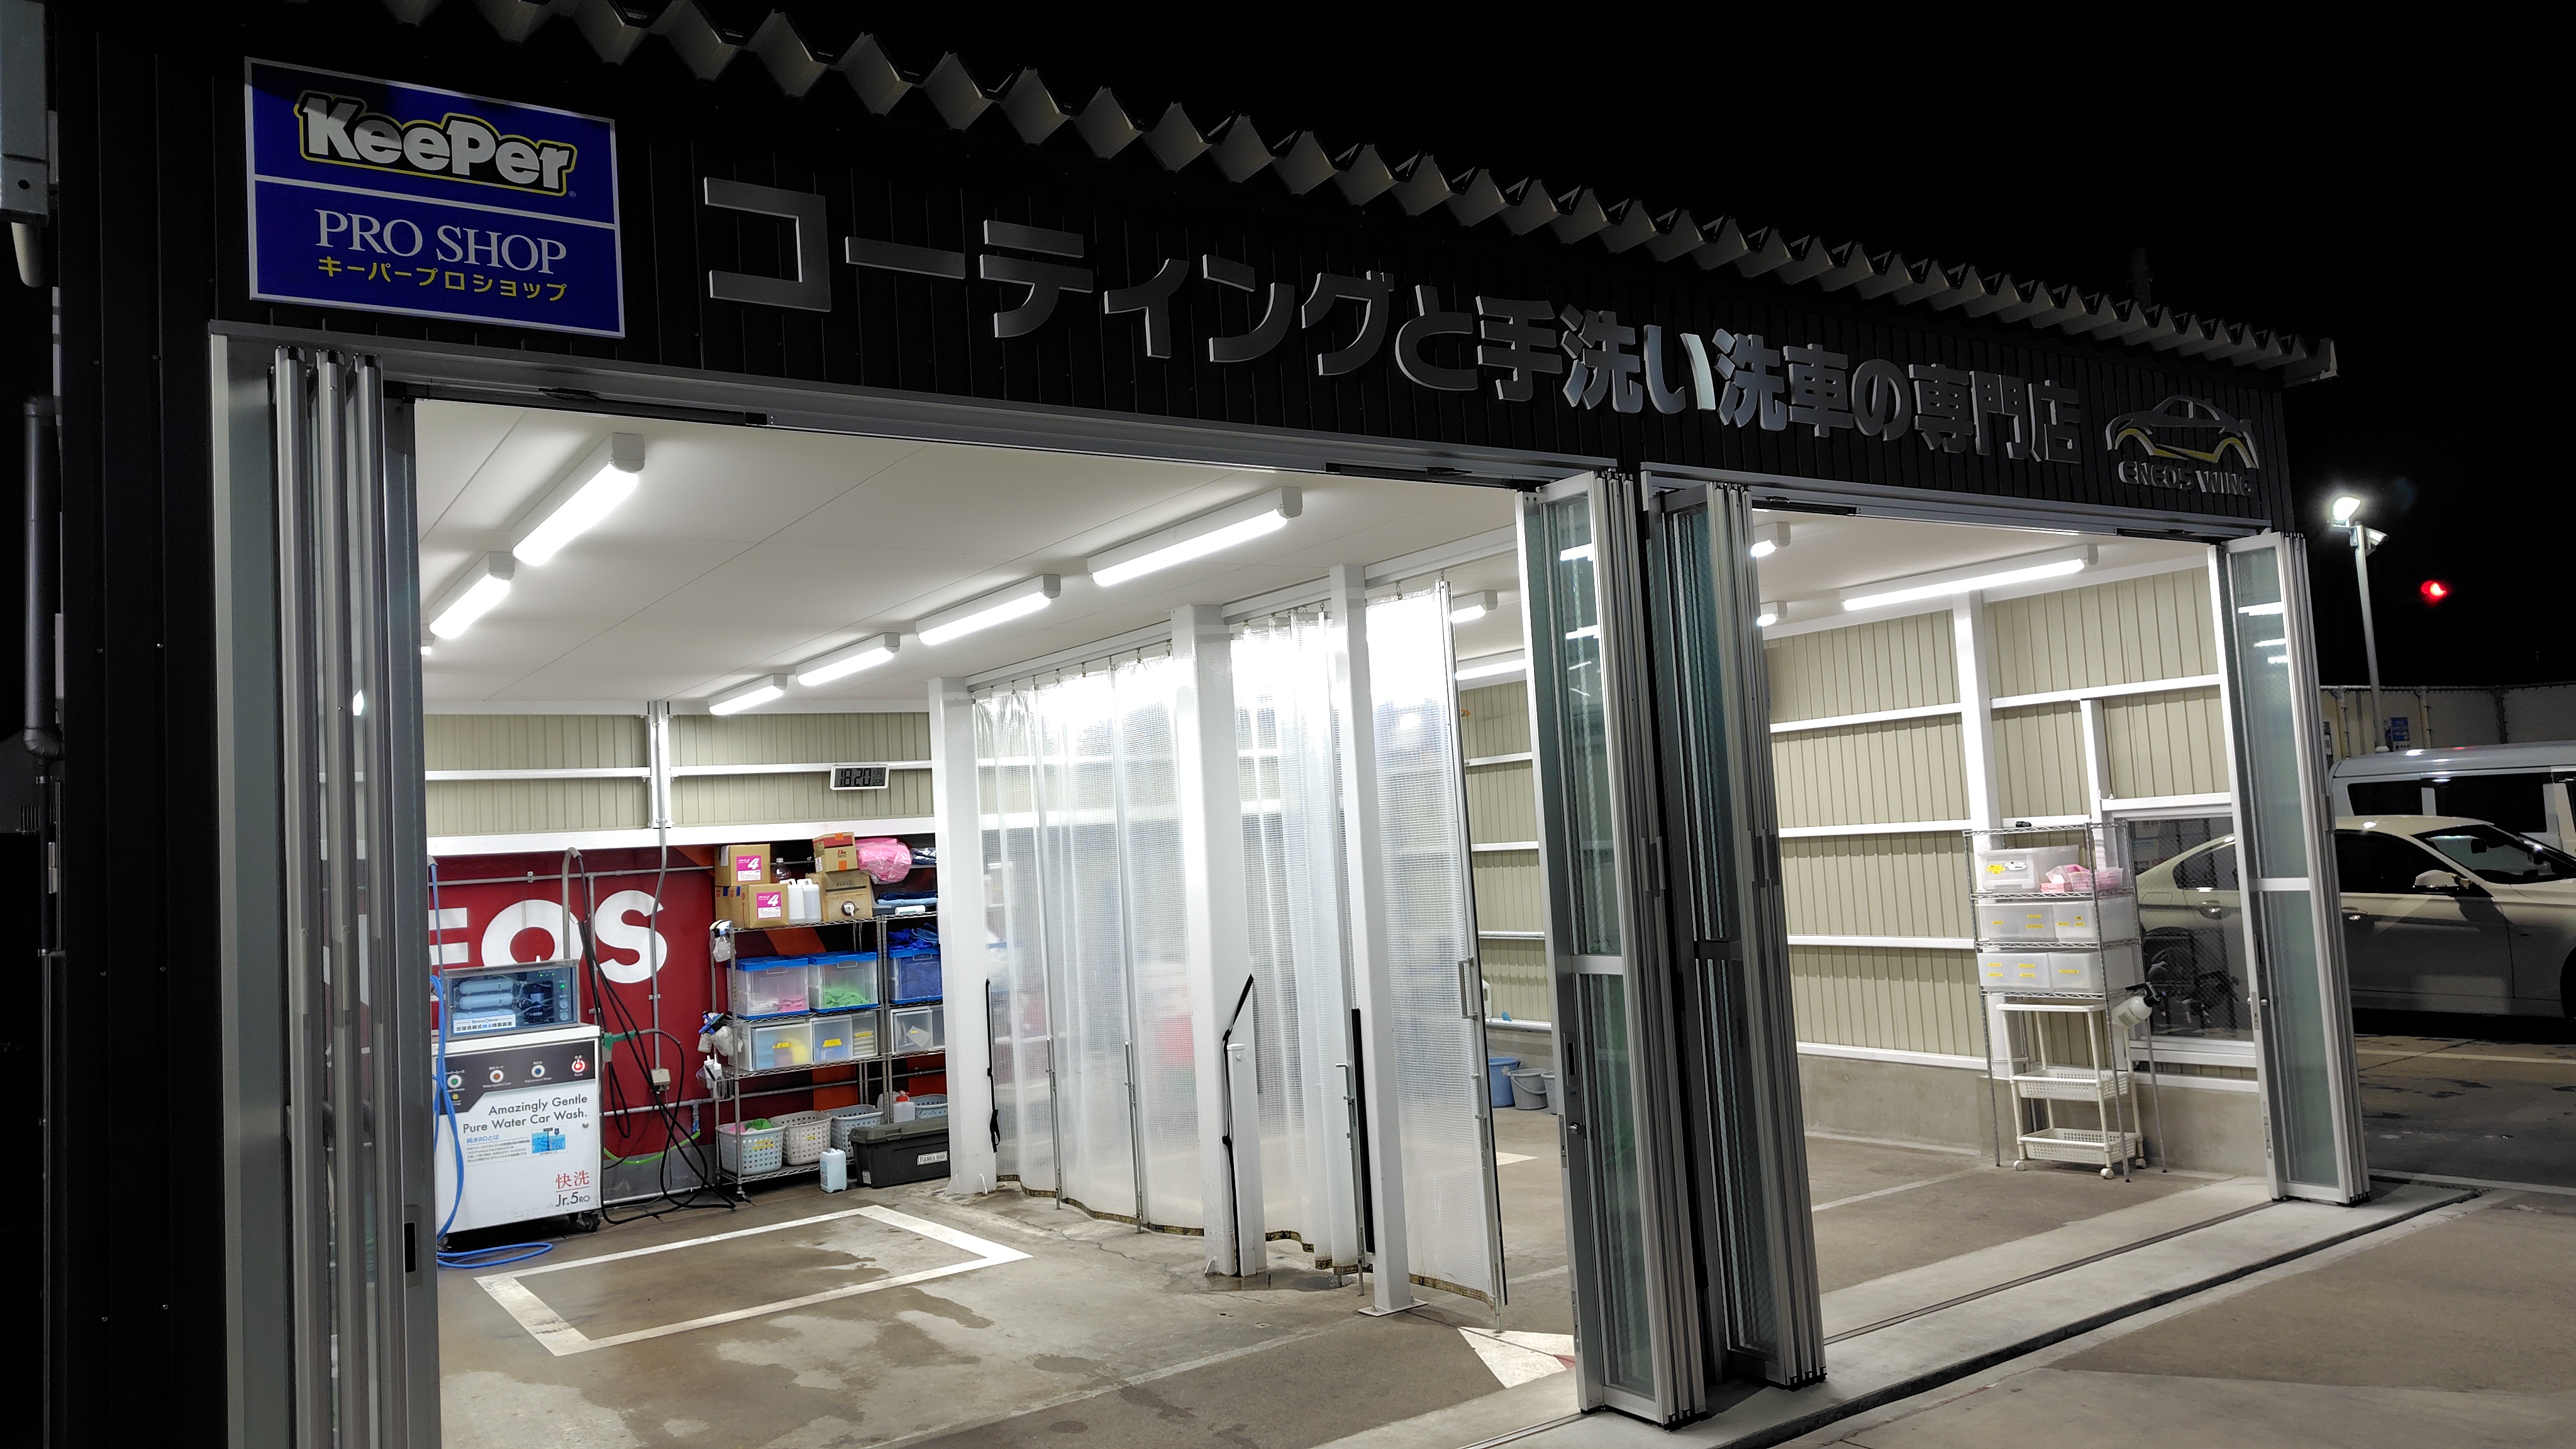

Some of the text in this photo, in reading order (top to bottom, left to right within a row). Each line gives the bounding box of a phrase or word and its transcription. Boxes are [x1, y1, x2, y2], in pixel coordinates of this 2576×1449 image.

[303, 97, 570, 190] KeePer
[314, 209, 567, 274] PRO SHOP
[318, 256, 567, 301] キーパープロショップ
[703, 176, 2083, 464] コーティングと手洗い洗車の専門店
[2118, 460, 2253, 496] ENEOS WING
[747, 857, 760, 870] 4
[767, 894, 779, 906] 4
[488, 1094, 587, 1116] Amazingly Gentle
[463, 1108, 588, 1133] Pure Water Car Wash.
[555, 1170, 590, 1189] 快洗
